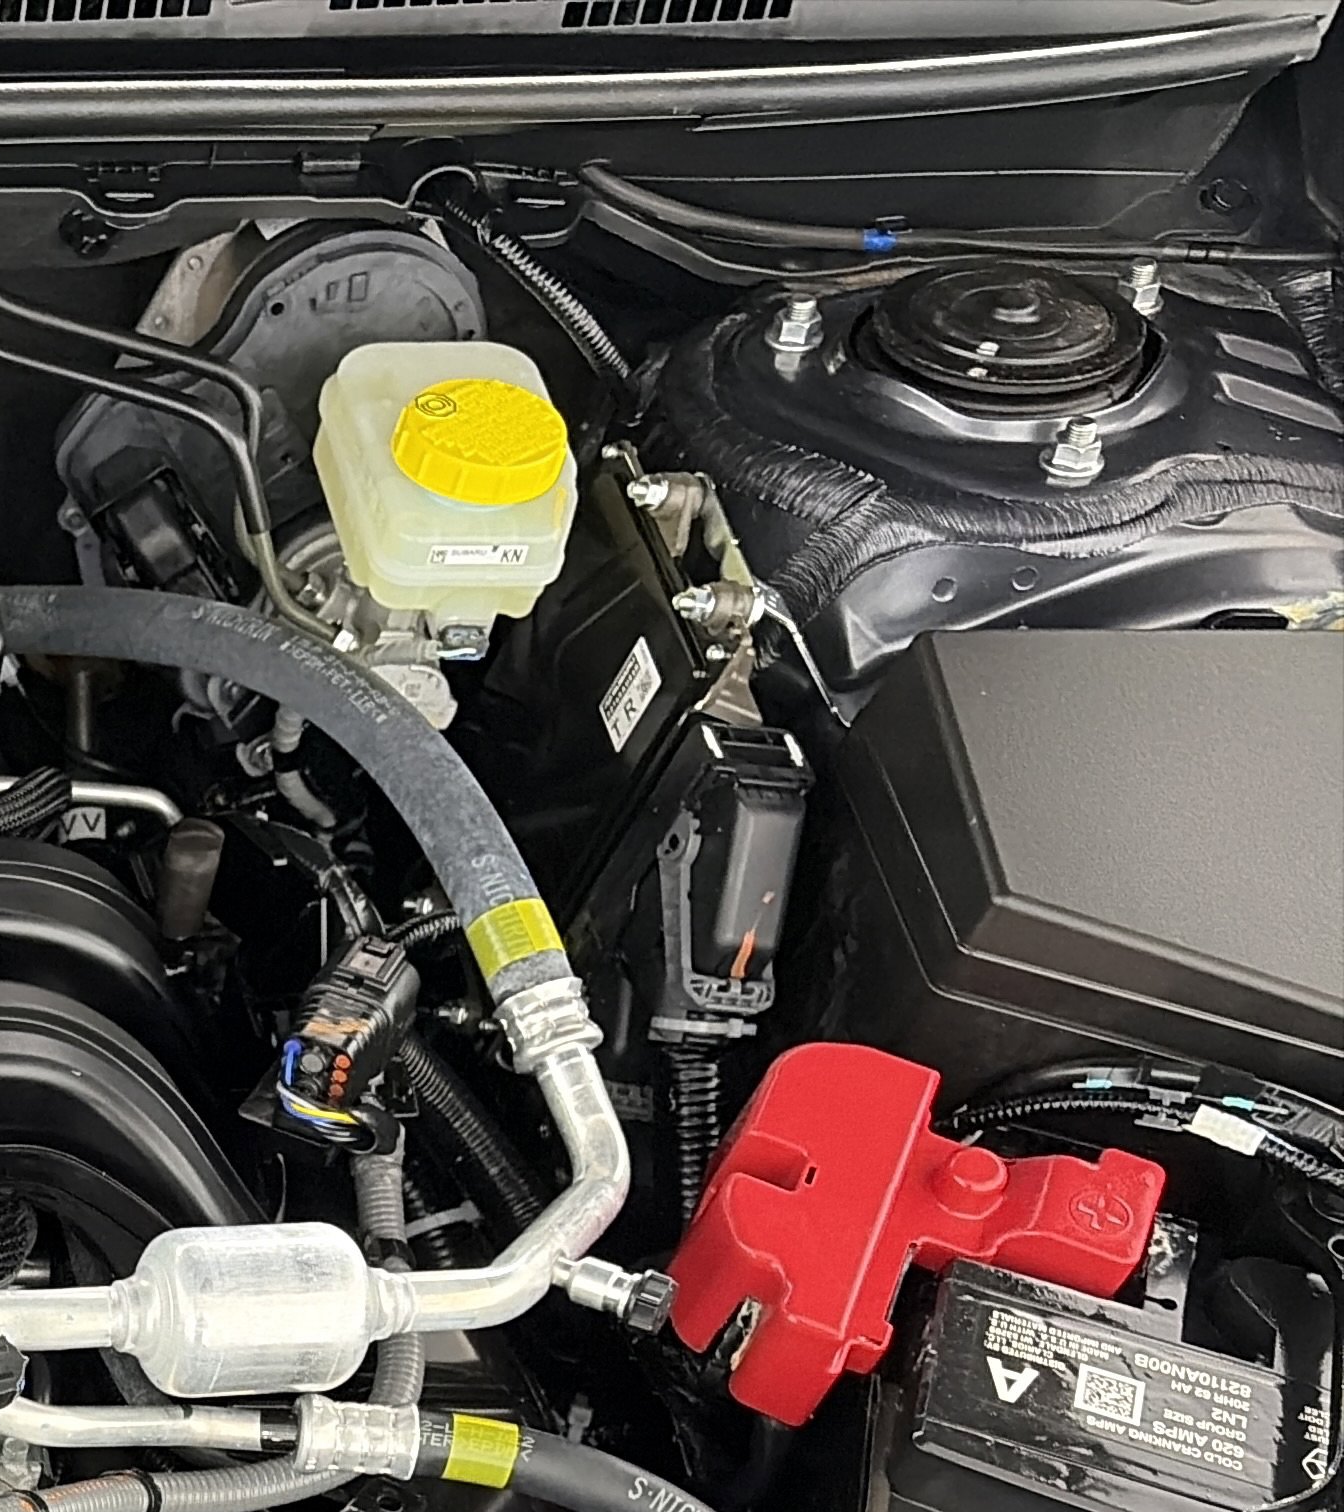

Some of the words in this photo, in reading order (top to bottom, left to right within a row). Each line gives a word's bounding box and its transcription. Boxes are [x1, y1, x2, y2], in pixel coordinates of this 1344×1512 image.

[500, 549, 523, 563] KN
[1048, 1326, 1100, 1349] IMPORTED
[1001, 1344, 1067, 1371] DISTRIBUTED
[1081, 1346, 1110, 1360] MADE
[1100, 1341, 1123, 1355] AND
[1134, 1353, 1252, 1399] 82110AN00B
[1170, 1380, 1193, 1394] AH
[1213, 1393, 1251, 1412] 20HR
[1086, 1415, 1127, 1435] AMPS
[1163, 1408, 1194, 1426] SIZE
[1211, 1407, 1248, 1429] LN2
[1152, 1420, 1209, 1447] AMPS
[1195, 1421, 1247, 1442] GROUP
[1128, 1427, 1202, 1459] CRANKING
[1211, 1438, 1245, 1459] 620
[1203, 1451, 1243, 1471] COLD
